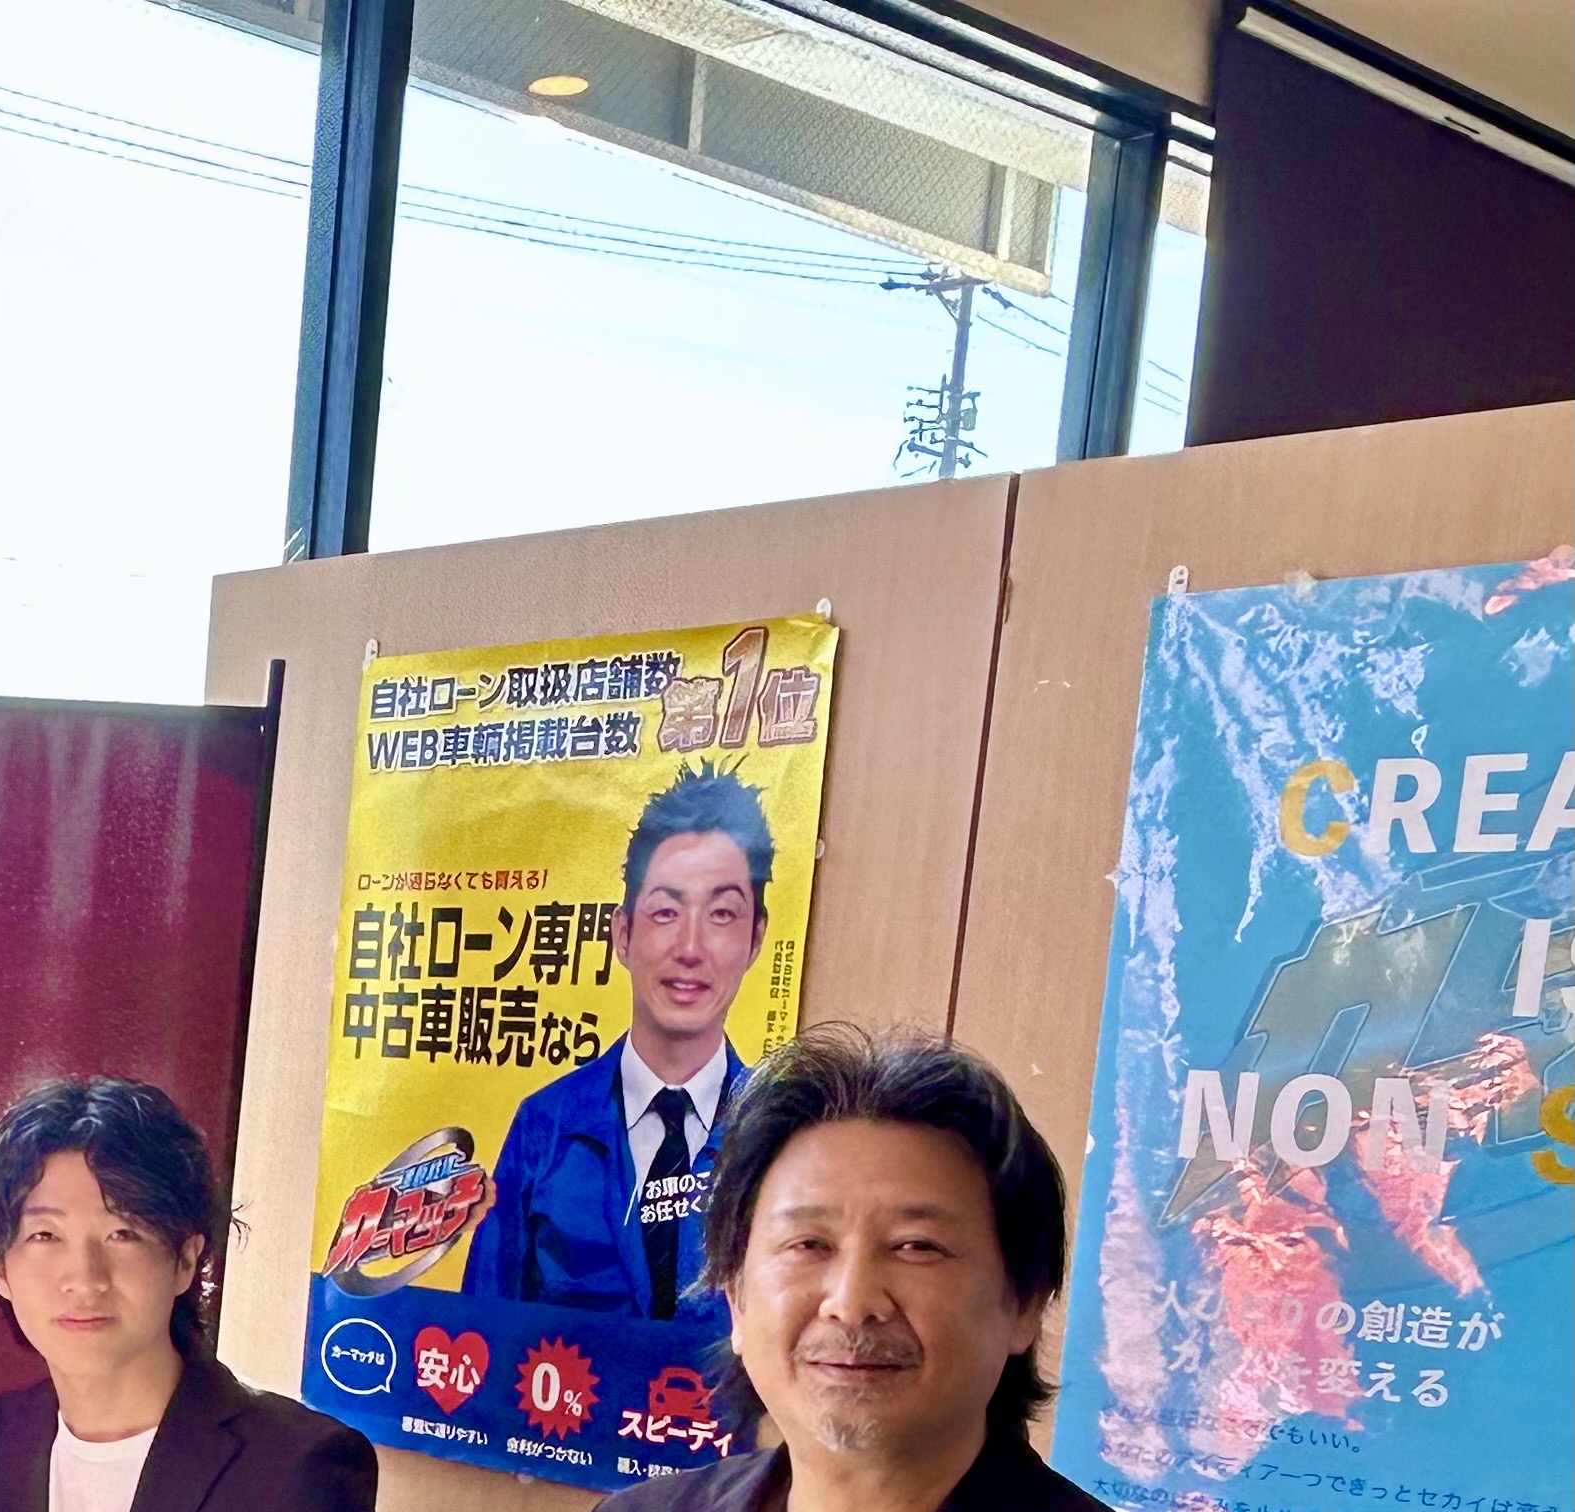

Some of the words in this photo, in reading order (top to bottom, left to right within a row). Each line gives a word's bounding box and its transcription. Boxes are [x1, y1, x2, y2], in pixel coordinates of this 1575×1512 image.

[658, 626, 821, 752] 第1位
[350, 900, 622, 986] 自社ローン専門
[343, 984, 601, 1067] 中古車販売なら
[1177, 1069, 1449, 1173] NON
[417, 1347, 481, 1395] 安心
[617, 1410, 733, 1458] スピーディ
